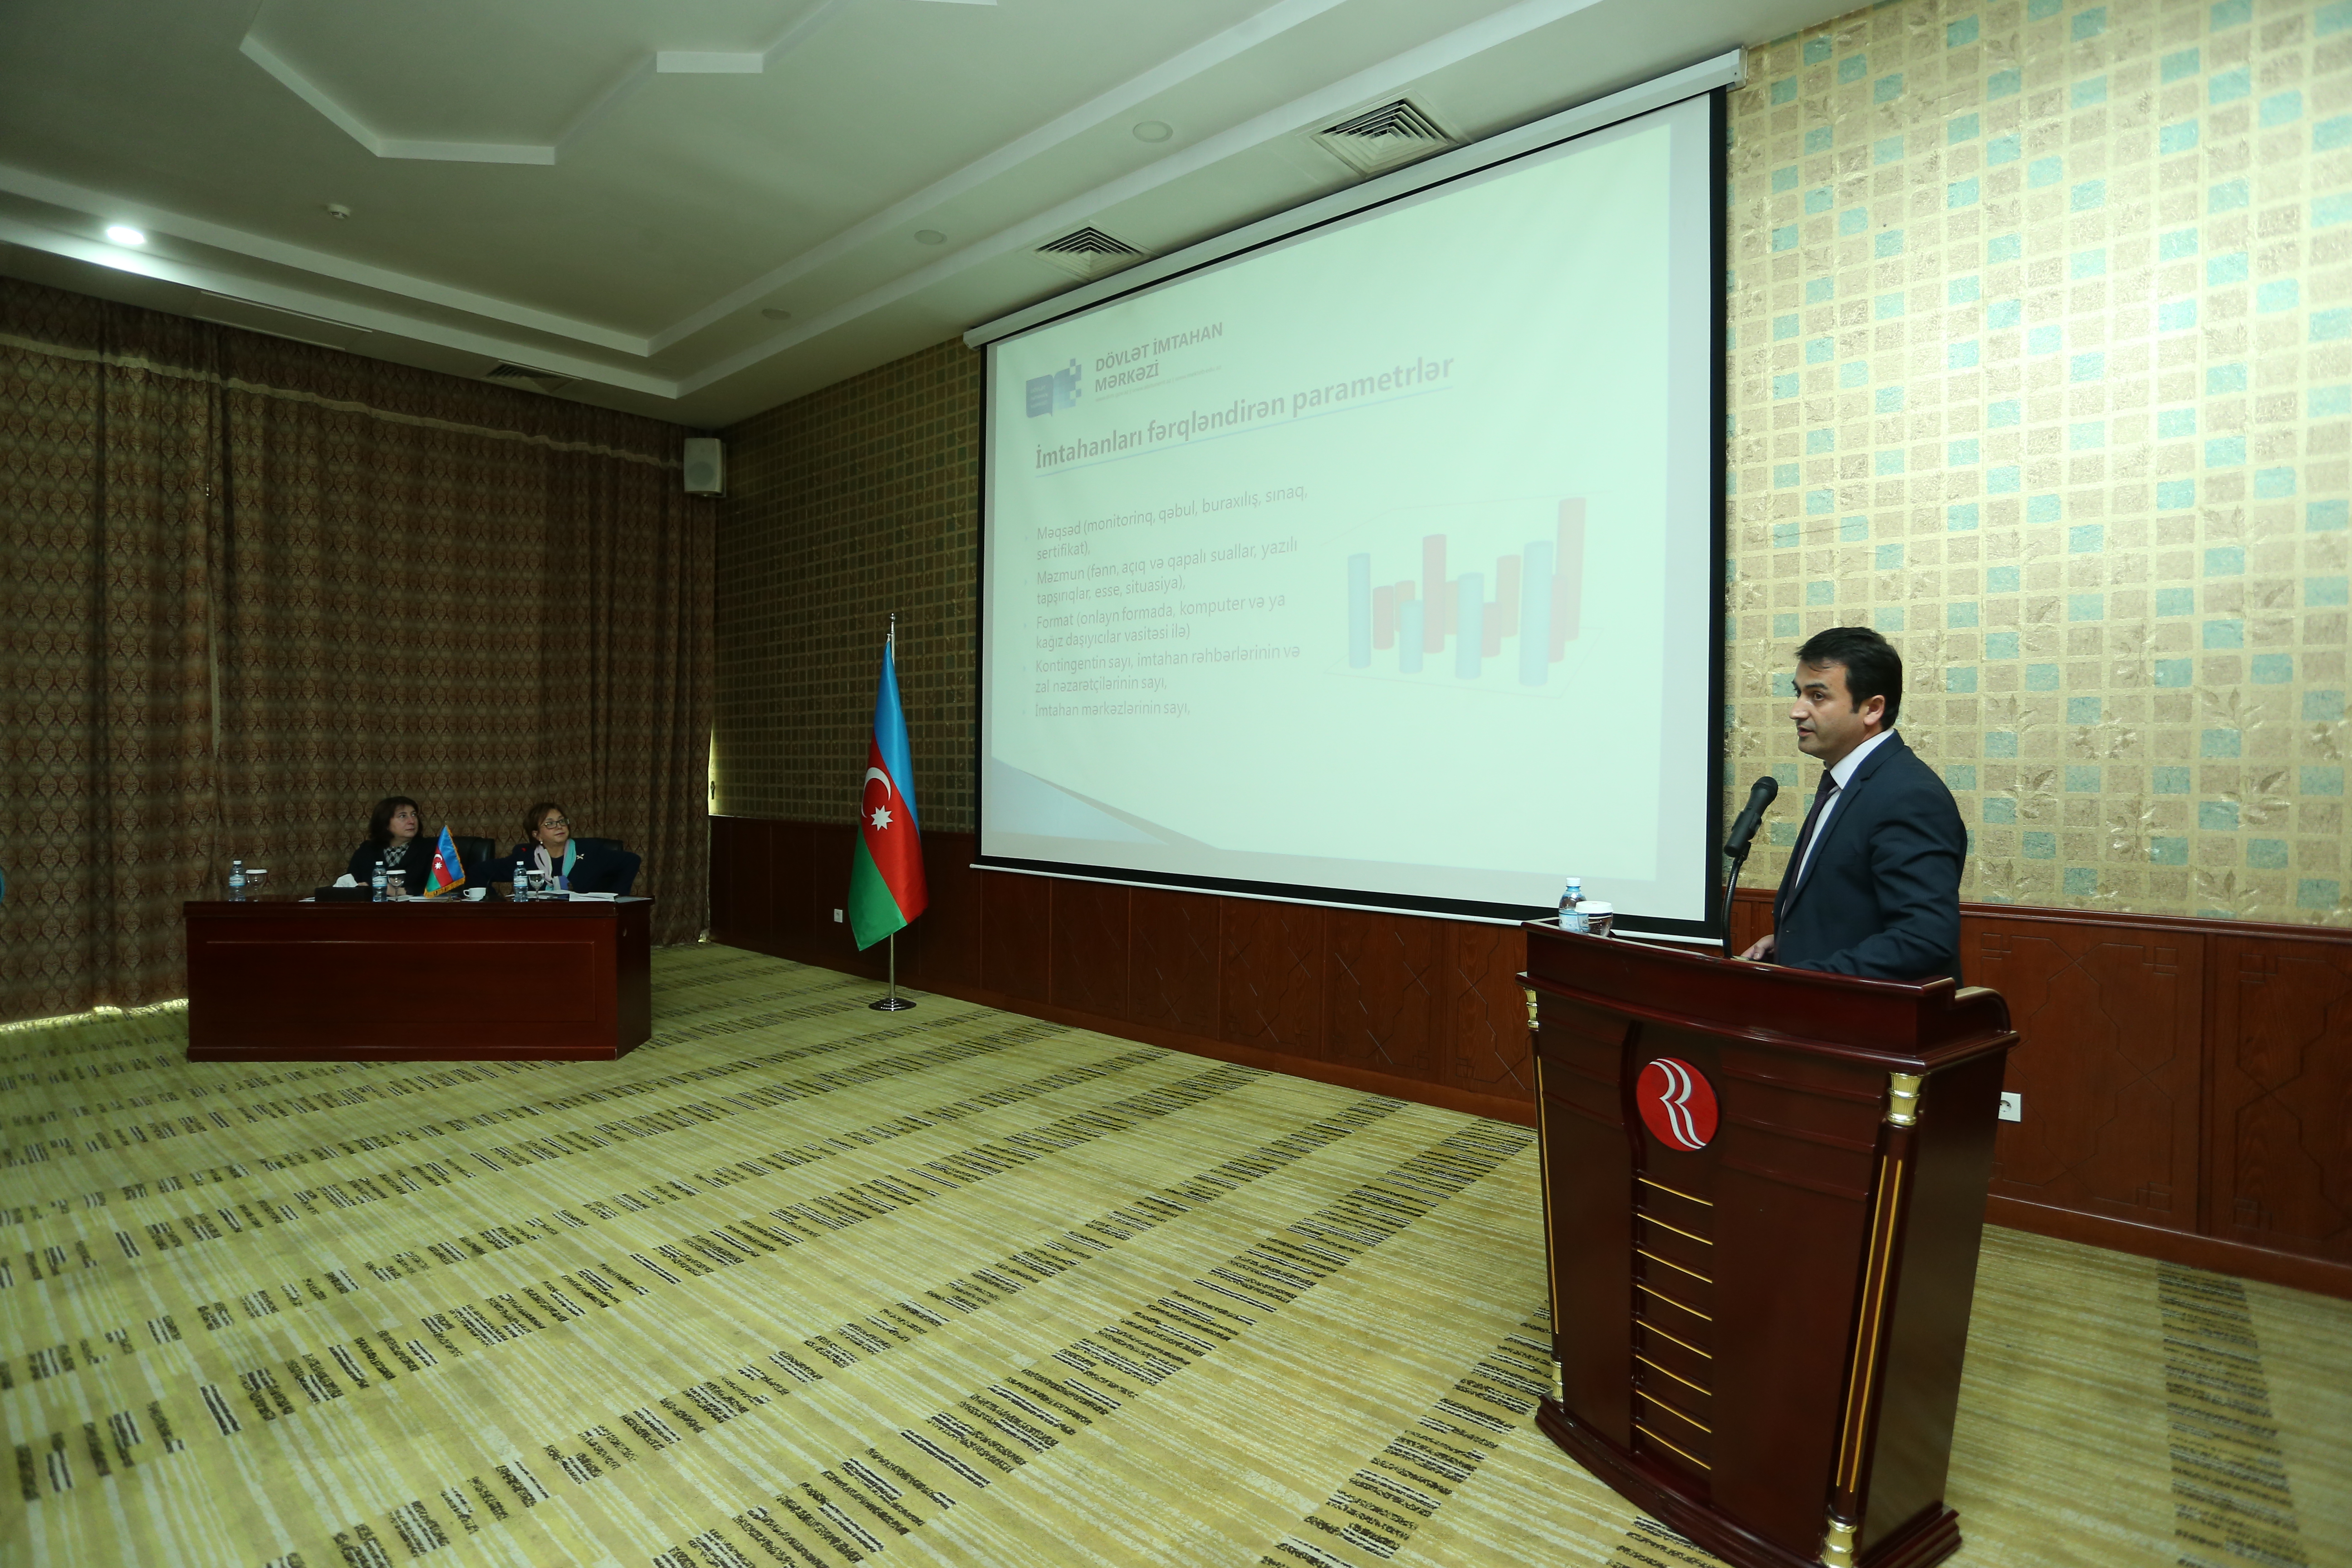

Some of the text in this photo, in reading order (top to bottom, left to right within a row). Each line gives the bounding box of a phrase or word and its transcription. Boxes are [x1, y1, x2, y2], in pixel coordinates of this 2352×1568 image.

[1096, 322, 1223, 372] DÖVLƏT İMTAHAN
[1095, 359, 1159, 392] MƏRKƏZİ
[1036, 356, 1454, 469] İmtahanları fərqləndirən parametrlər
[1037, 485, 1308, 541] Məqsəd (monitorinq, qəbul, buraxılış, sınaq,
[1037, 540, 1090, 560] sertifikat),
[1037, 535, 1297, 585] Məzmun (fənn, açıq və qapalı suallar, yazılı
[1037, 574, 1185, 608] tapşırıqlar, esse, situasiya),
[1037, 594, 1285, 629] Format (onlayn formada, komputer və ya
[1036, 622, 1190, 652] kağız daşıyıcılar vasitəsi ilə)
[1036, 643, 1300, 674] Kontingentin sayı, imtahan rəhbərlərinin və
[1035, 674, 1167, 694] zal nəzarətçilərinin sayı,
[1035, 700, 1190, 718] İmtahan mərkəzlərinin sayı,
